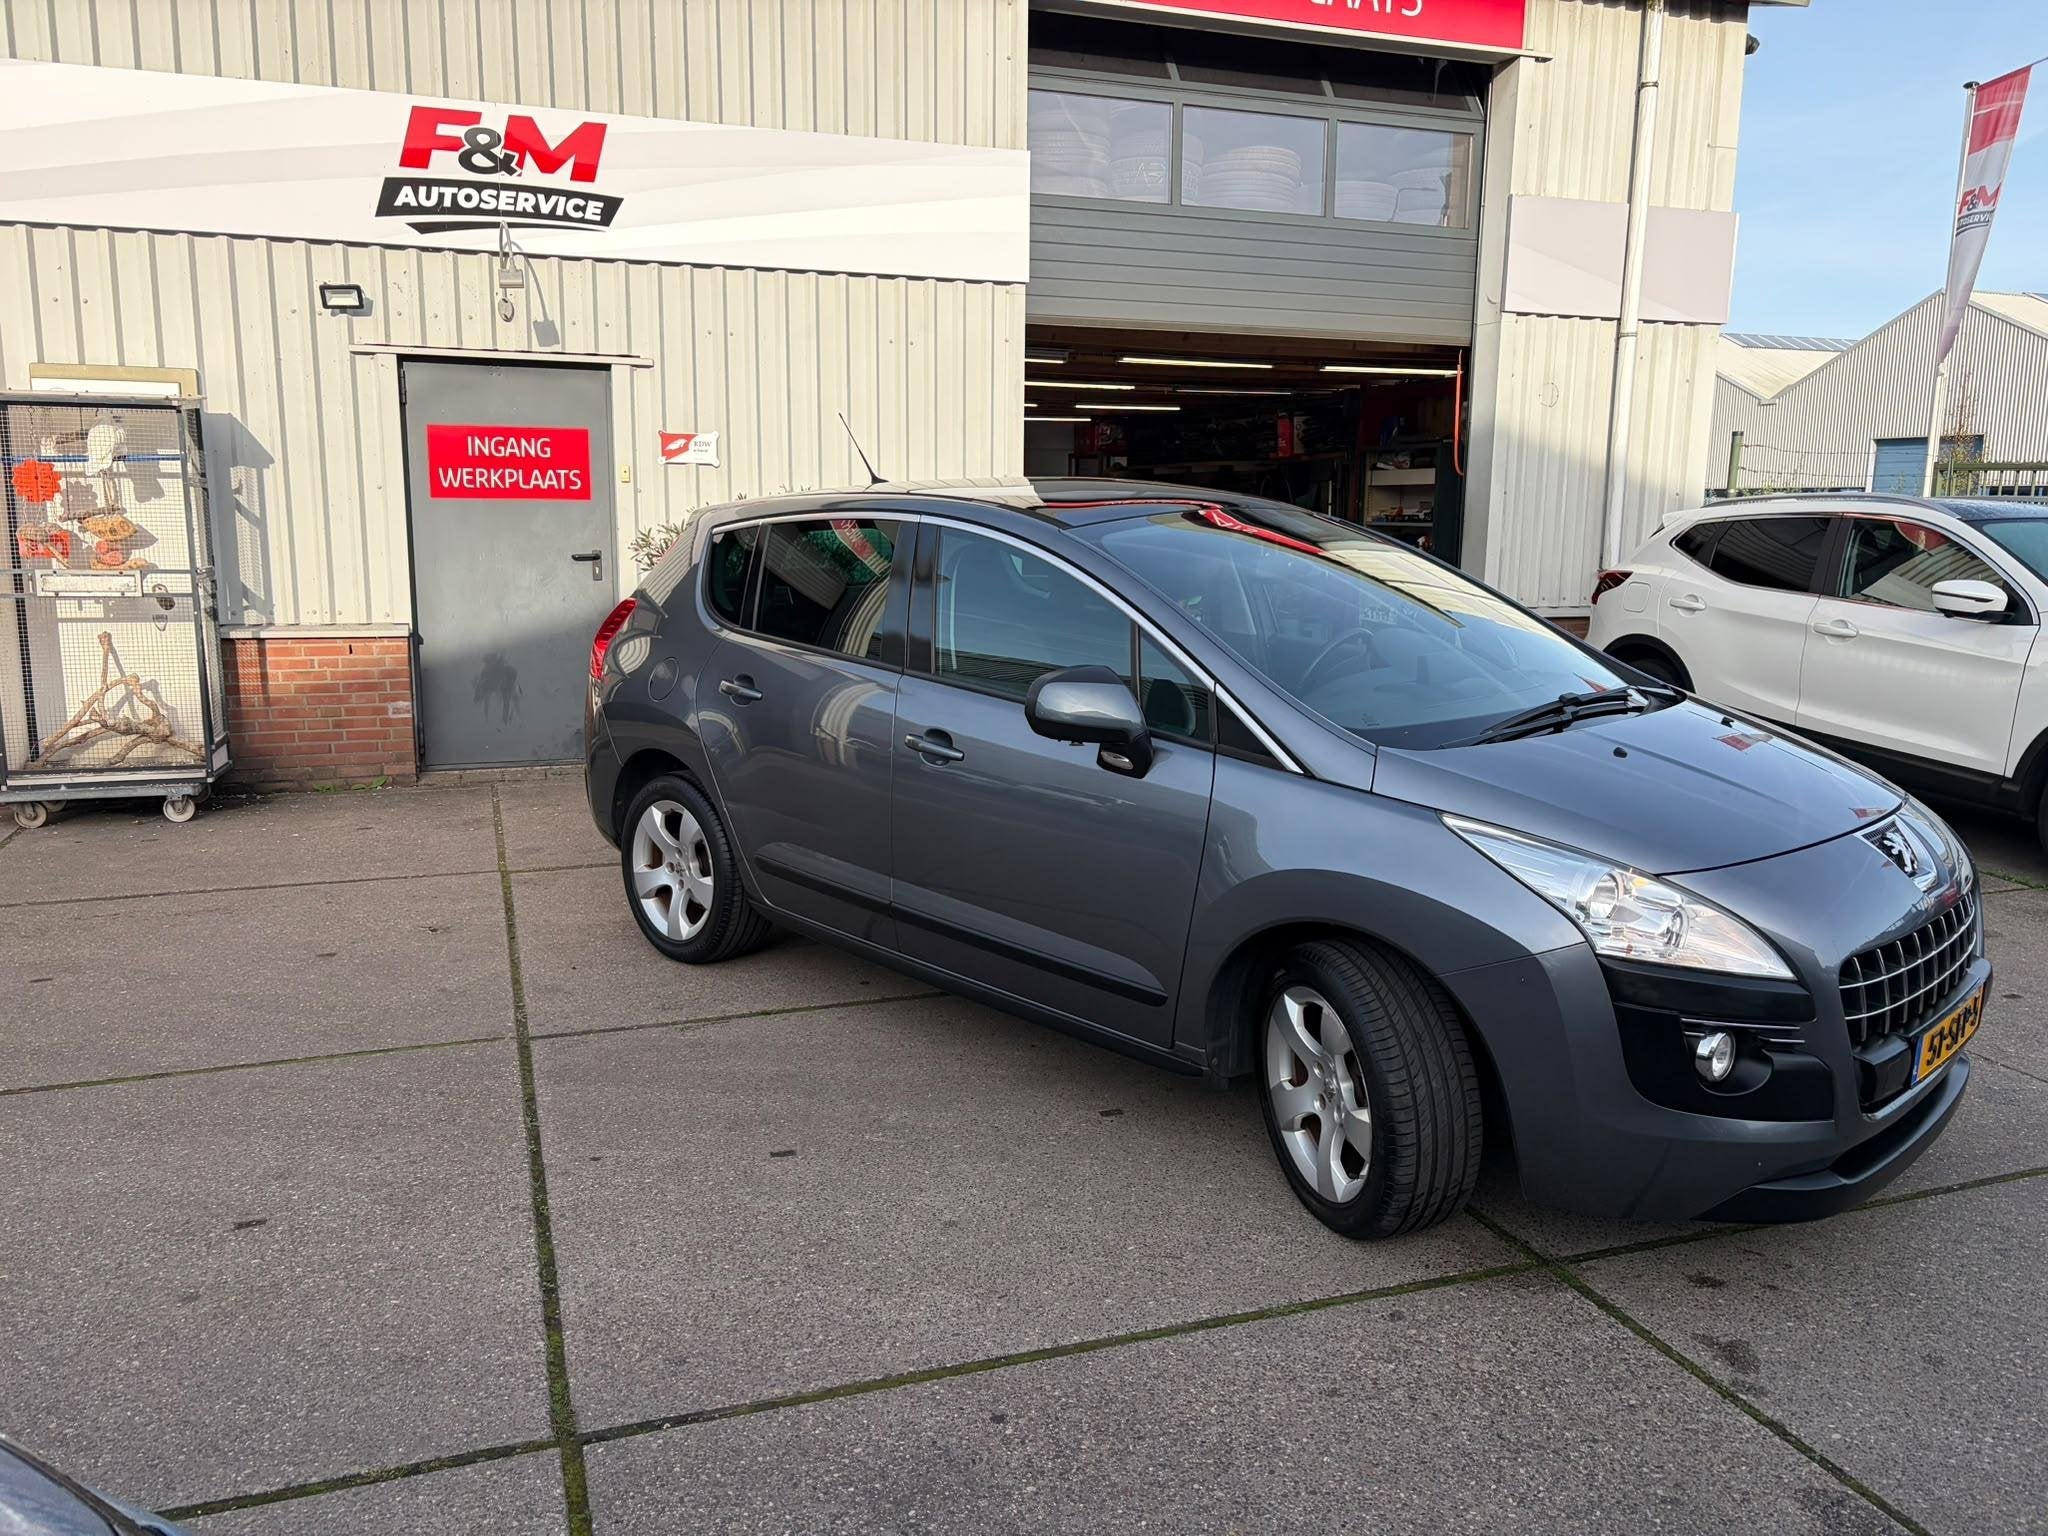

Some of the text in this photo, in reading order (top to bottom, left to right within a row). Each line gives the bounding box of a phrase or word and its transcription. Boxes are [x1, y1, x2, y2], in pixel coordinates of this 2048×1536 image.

[399, 105, 608, 183] F&M
[394, 185, 605, 221] AUTOSERVICE
[1958, 182, 2001, 216] F&M
[467, 435, 551, 458] INGANG
[438, 467, 582, 490] WERKPLAATS
